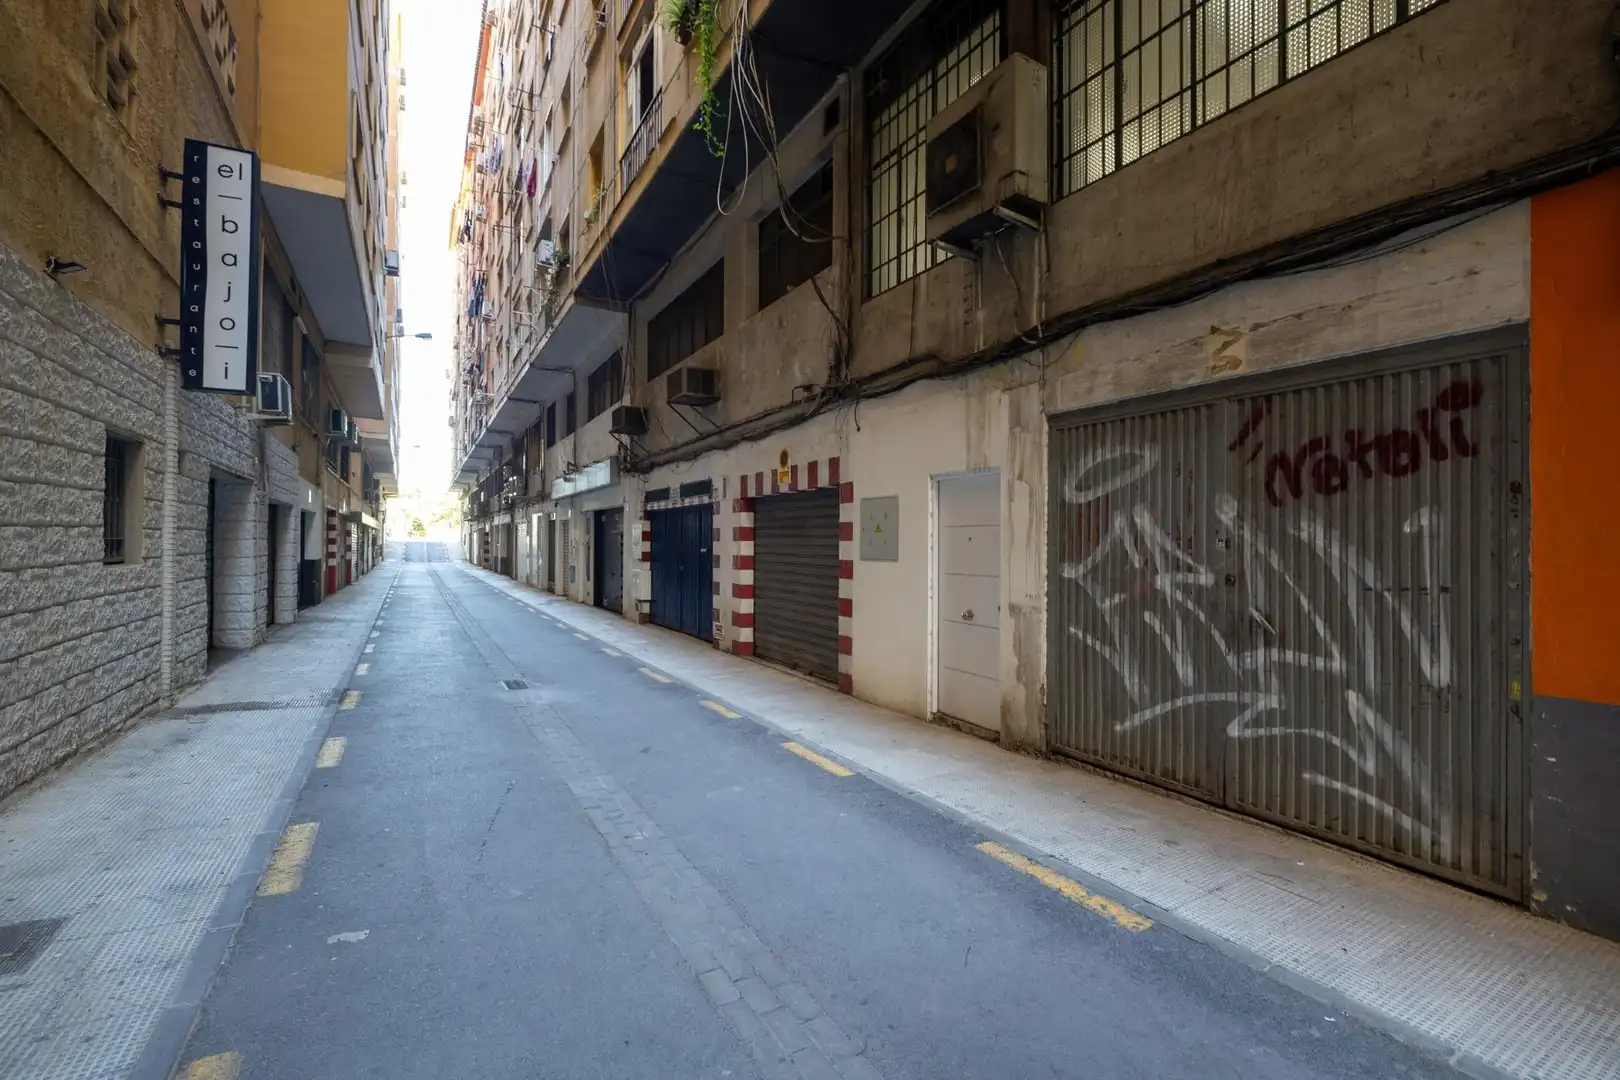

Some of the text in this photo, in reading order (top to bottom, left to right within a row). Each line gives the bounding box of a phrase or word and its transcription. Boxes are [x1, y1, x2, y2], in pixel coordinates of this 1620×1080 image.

[217, 163, 243, 181] el
[189, 154, 201, 377] restaurante
[219, 214, 239, 331] bajo
